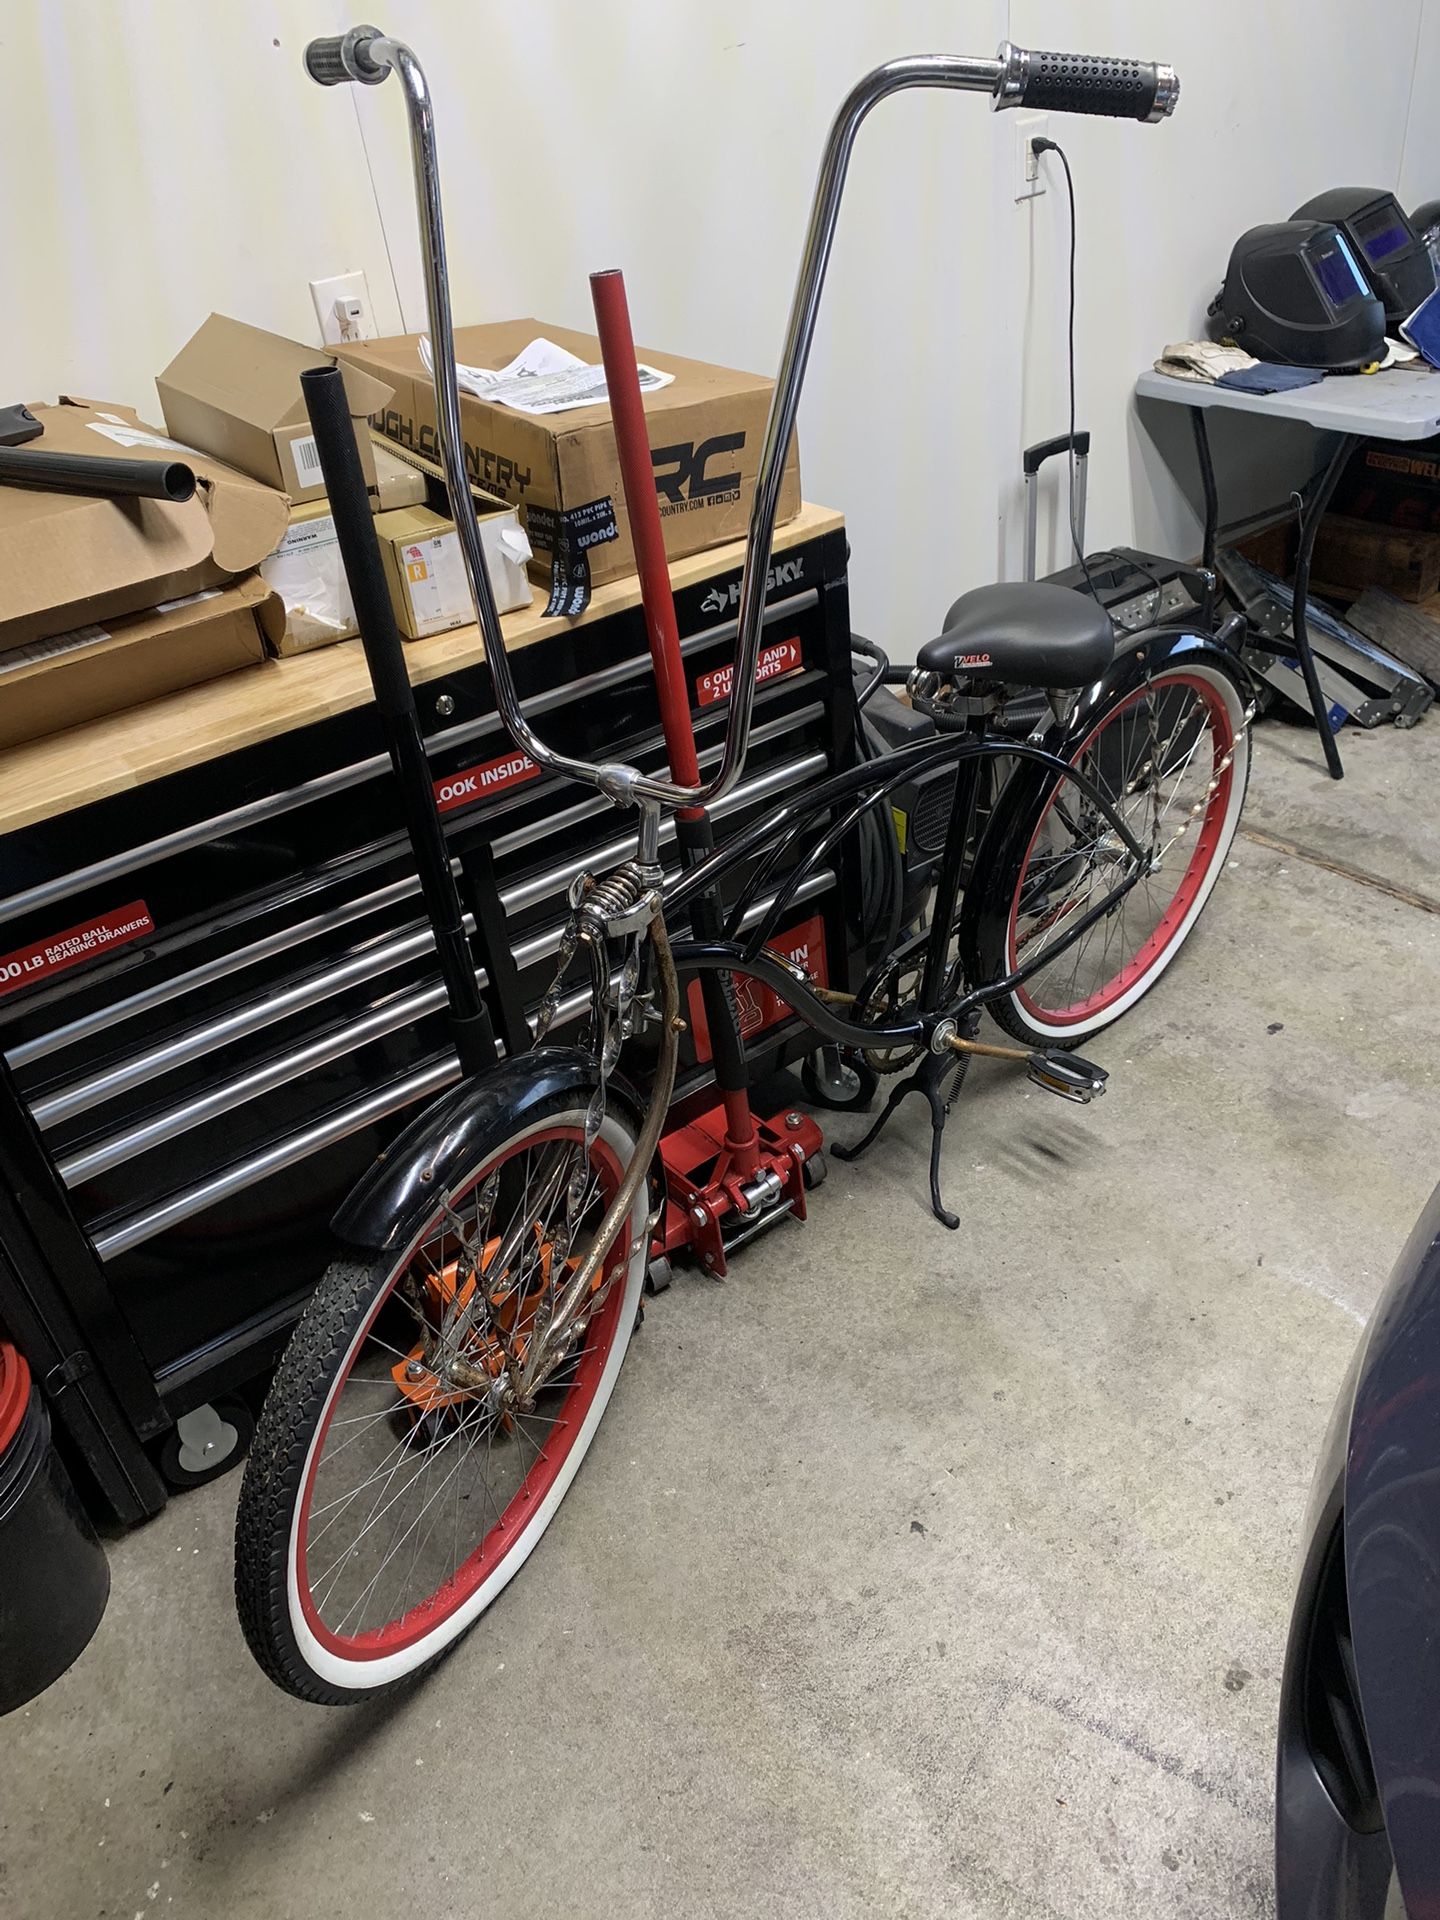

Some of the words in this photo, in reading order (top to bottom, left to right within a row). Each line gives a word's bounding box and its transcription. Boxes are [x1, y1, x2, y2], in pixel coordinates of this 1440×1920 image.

[368, 408, 413, 445] UGH
[419, 424, 532, 494] CNTRY
[650, 431, 746, 504] RC
[468, 472, 507, 499] TEMS
[286, 533, 317, 545] WARNING
[413, 564, 424, 579] R
[728, 557, 804, 605] HSKY
[703, 677, 711, 689] 6
[763, 645, 788, 665] AND
[963, 653, 990, 664] VELO
[713, 686, 720, 698] 2
[755, 660, 781, 680] ORTS
[436, 776, 478, 804] OOK
[480, 756, 534, 786] INSIDE
[44, 937, 81, 958] RATED
[81, 925, 110, 942] BALL
[47, 938, 97, 965] BEARING
[98, 916, 150, 944] DRAWERS
[23, 955, 44, 972] LB
